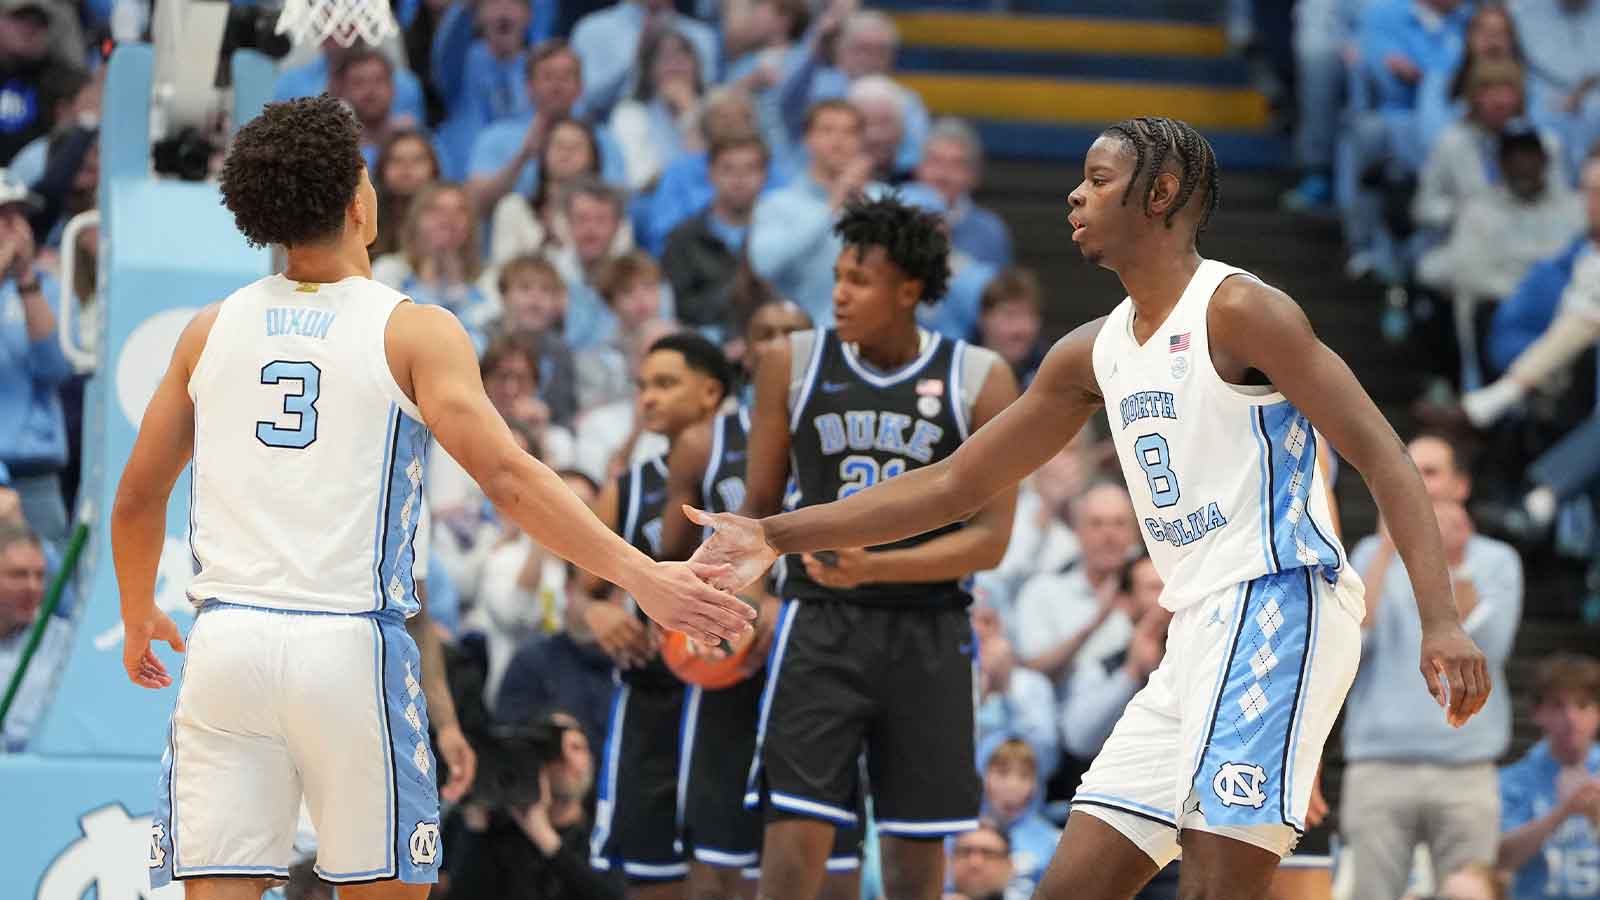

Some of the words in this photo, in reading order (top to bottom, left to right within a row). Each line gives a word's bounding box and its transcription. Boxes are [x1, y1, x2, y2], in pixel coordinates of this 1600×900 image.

[266, 307, 336, 339] DIXON
[255, 359, 322, 449] 3
[1119, 390, 1177, 430] NORTH
[813, 410, 944, 464] DUKE
[1134, 432, 1181, 508] 8
